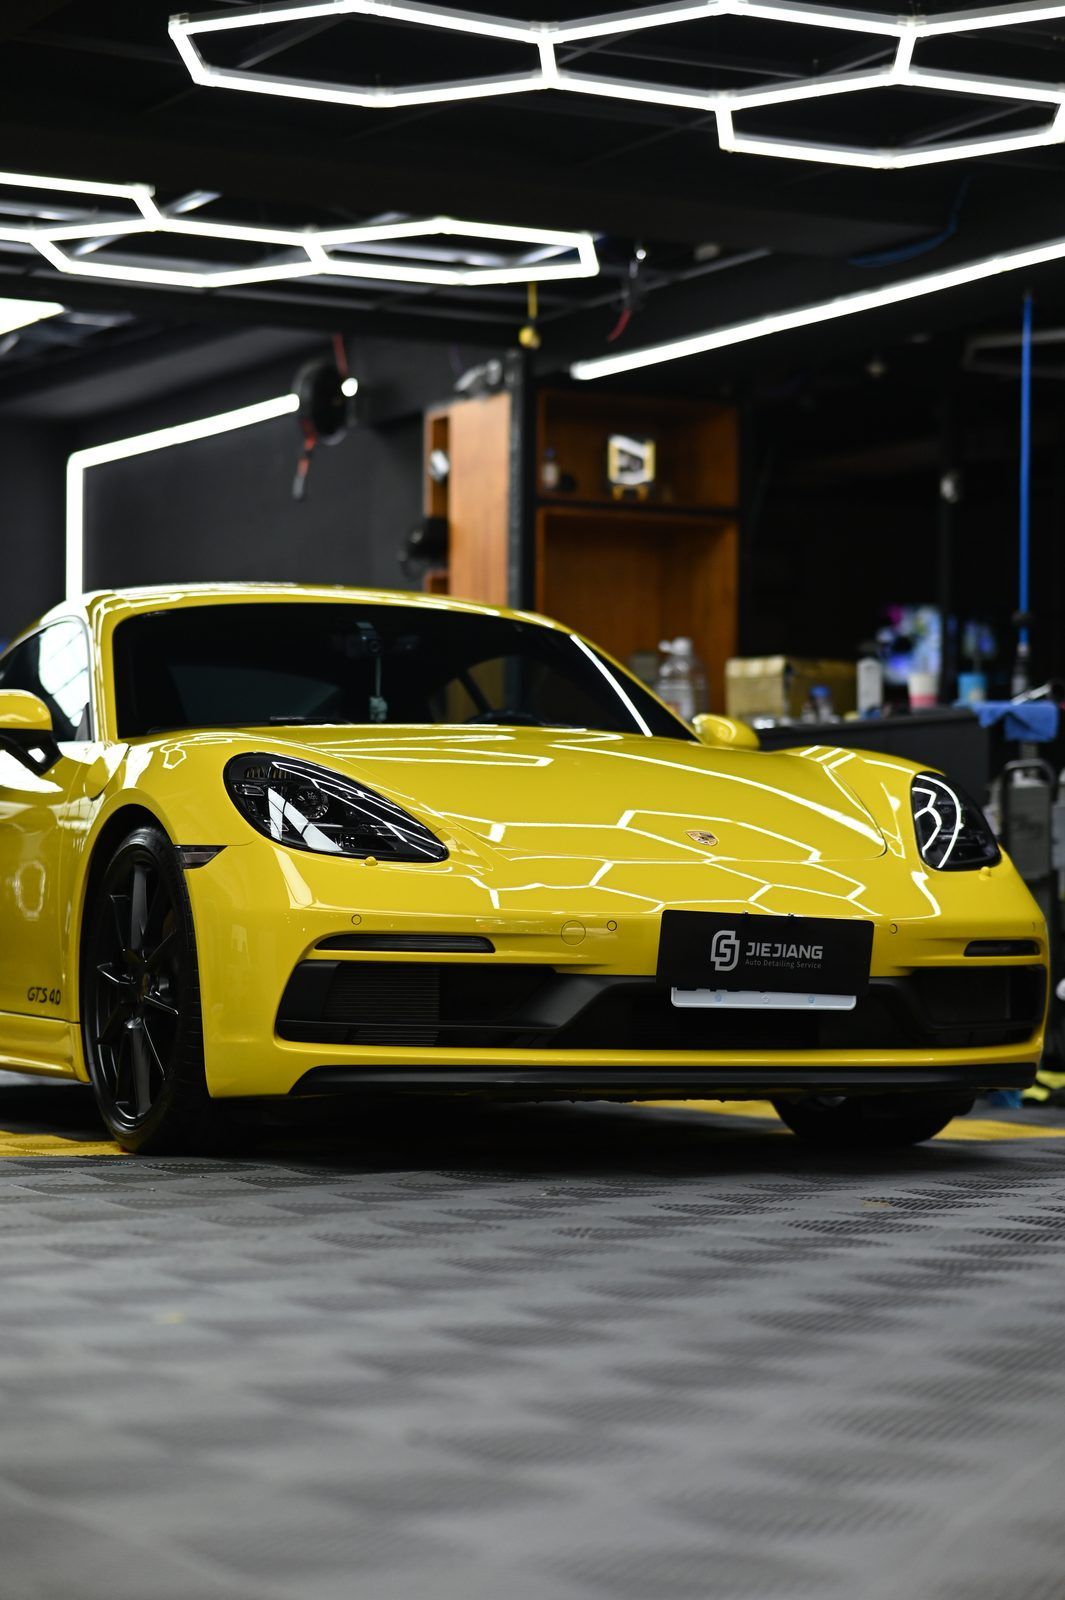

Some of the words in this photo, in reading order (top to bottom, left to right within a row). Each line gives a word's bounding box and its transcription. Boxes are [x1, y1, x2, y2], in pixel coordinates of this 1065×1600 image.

[745, 941, 824, 960] JIEJIANG
[745, 959, 762, 967] Auto
[763, 960, 796, 970] Detailing
[796, 961, 822, 969] Service
[27, 986, 47, 1003] GTS
